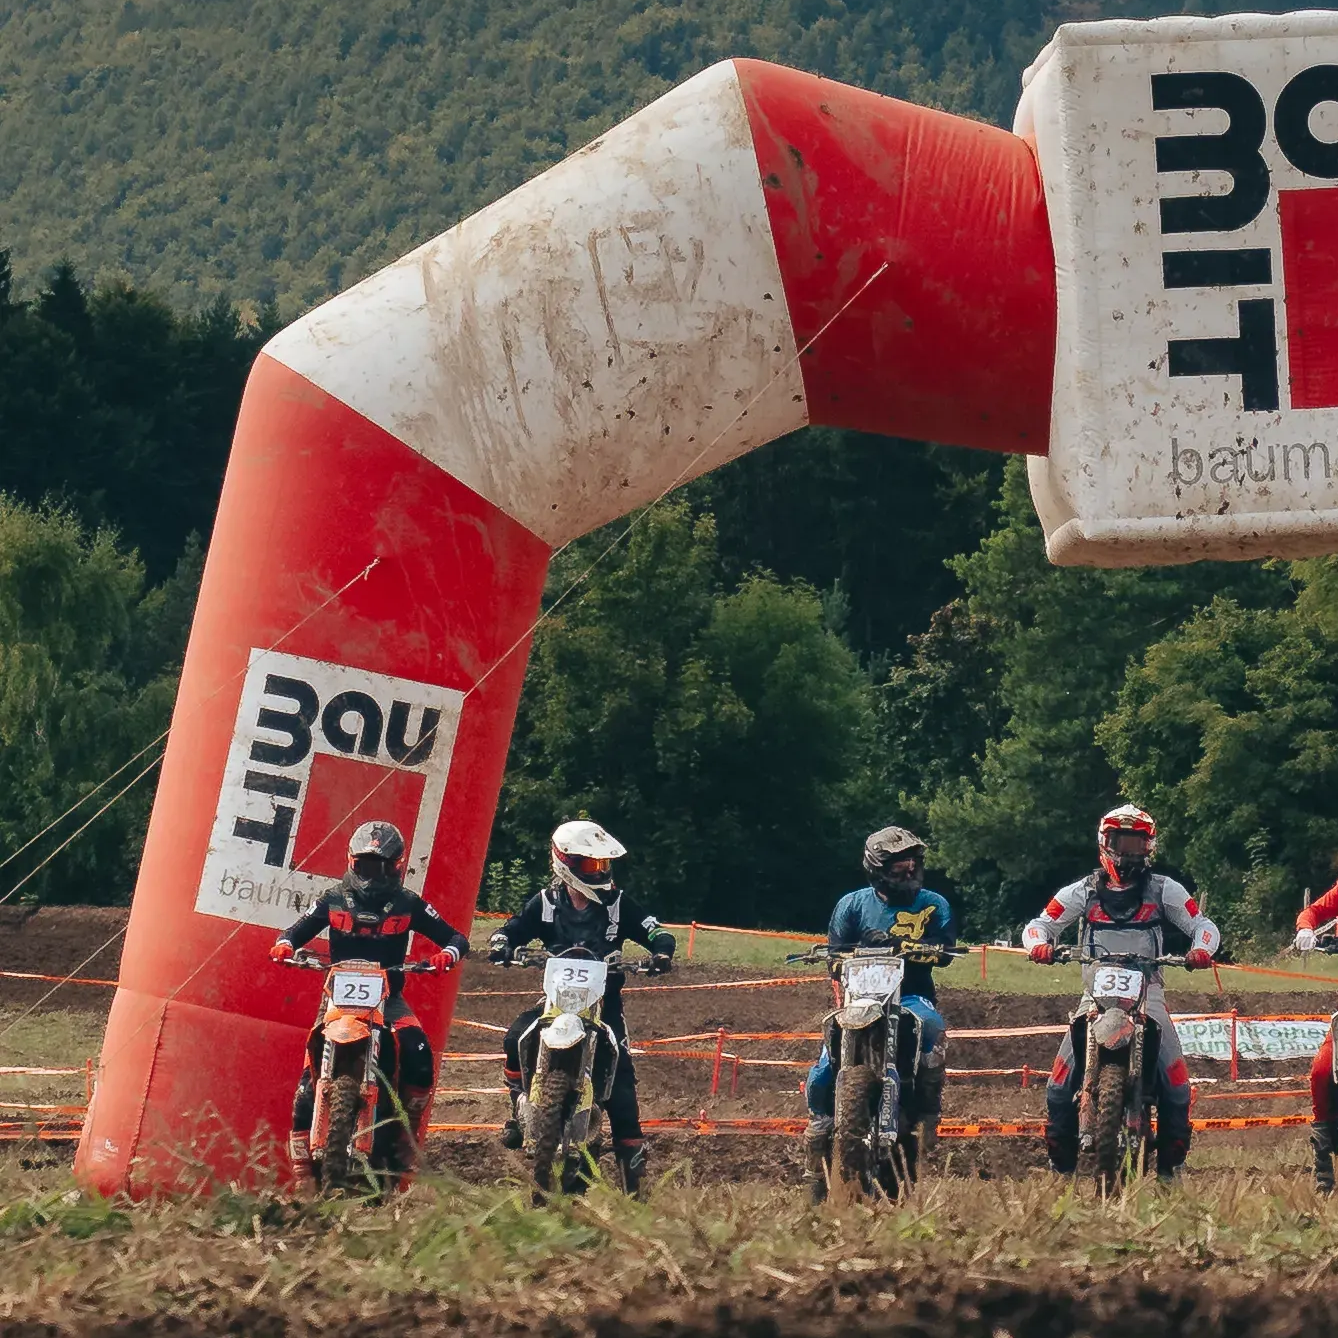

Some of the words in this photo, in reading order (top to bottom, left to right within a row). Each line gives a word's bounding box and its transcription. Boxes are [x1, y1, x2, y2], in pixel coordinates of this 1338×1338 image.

[562, 968, 589, 982] 35
[1101, 974, 1132, 991] 33
[343, 983, 370, 1000] 25
